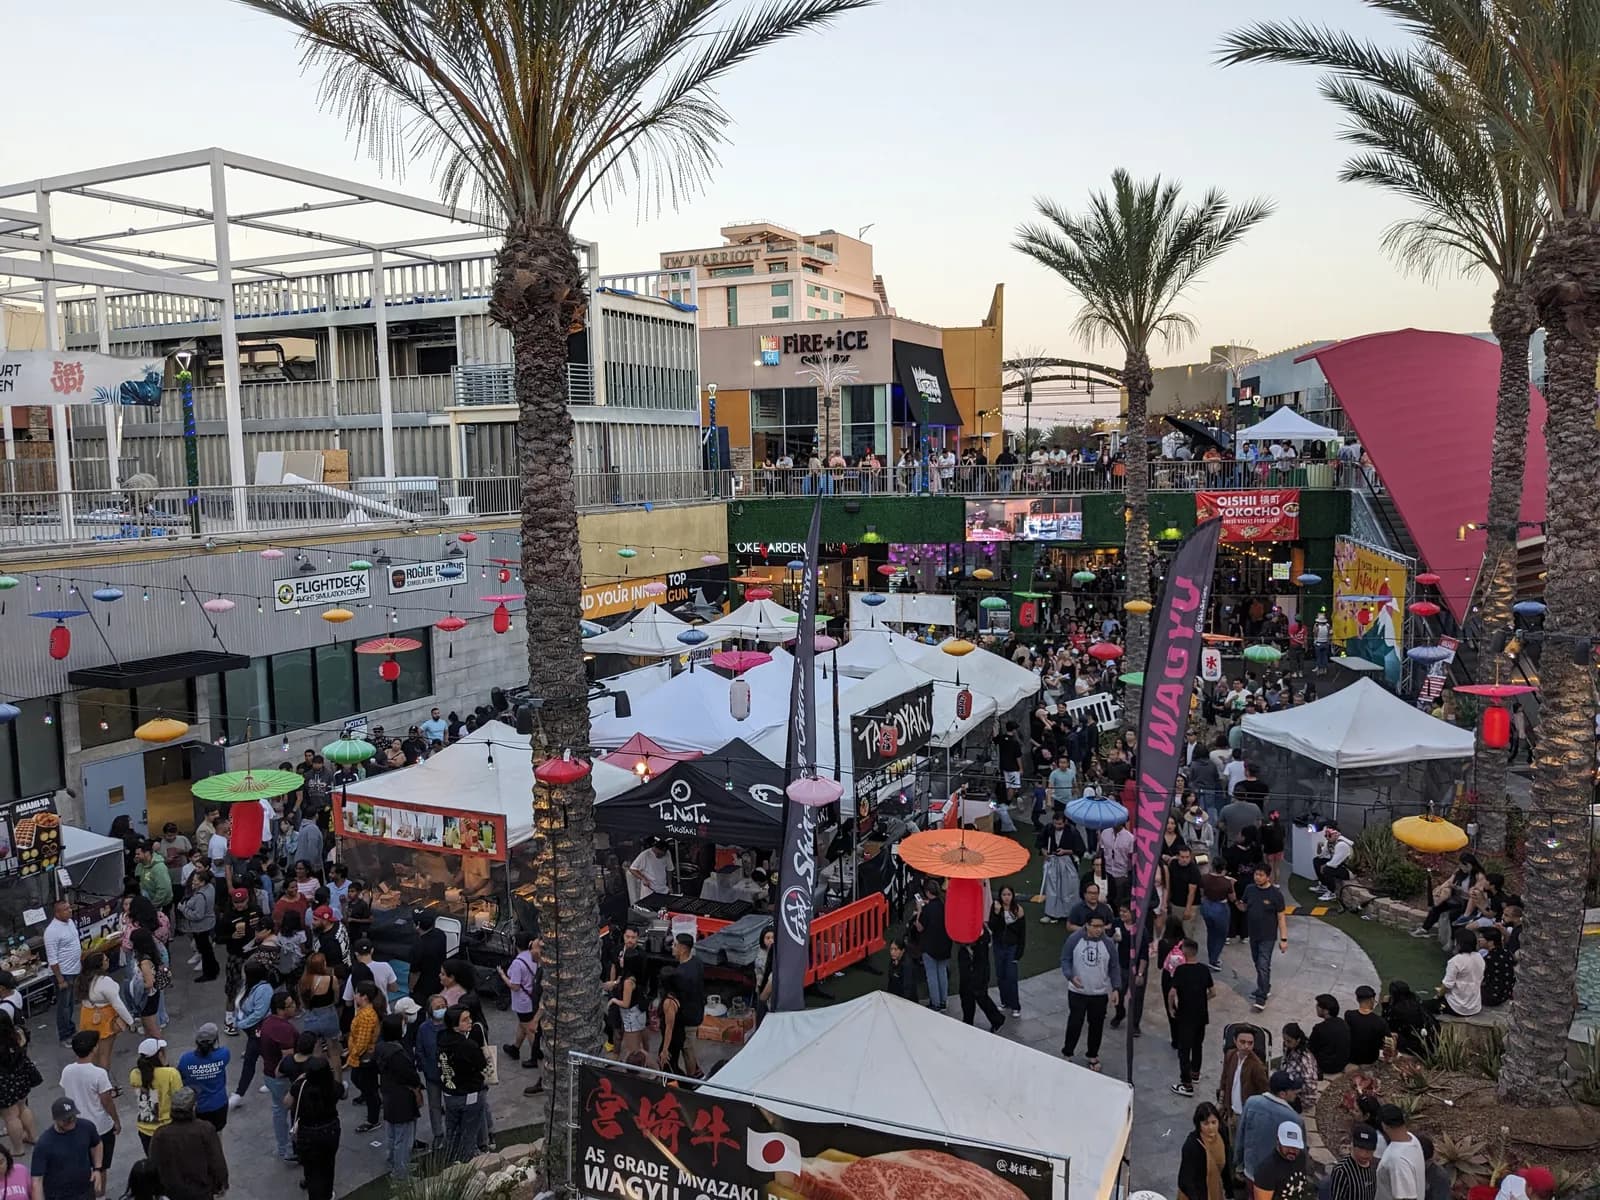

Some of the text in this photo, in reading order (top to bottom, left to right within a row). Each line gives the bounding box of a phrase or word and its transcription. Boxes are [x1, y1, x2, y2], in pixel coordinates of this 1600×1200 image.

[664, 249, 761, 268] JW MARRIOTT
[53, 361, 84, 375] Eat
[1216, 495, 1256, 506] OISHII
[1217, 506, 1280, 517] YOKOCHO
[762, 542, 806, 553] ARDEN
[406, 565, 433, 579] ROGUE
[669, 572, 687, 587] TOP
[296, 573, 366, 595] FLIGHTDECK
[315, 590, 346, 601] SIMULATION
[346, 586, 366, 597] CENTER
[597, 587, 629, 607] YOUR
[631, 584, 664, 601] INN
[668, 587, 688, 602] GUN
[1147, 576, 1201, 756] WAGYU
[858, 696, 931, 760] TAOYAKI
[665, 824, 697, 836] TAKOYAKI
[192, 1066, 220, 1075] DODGERS
[199, 1060, 224, 1069] ANGELES
[585, 1077, 741, 1167] 宮崎牛
[585, 1146, 759, 1199] A5 GRADE MIYAZAKI
[584, 1164, 679, 1200] WAGYU
